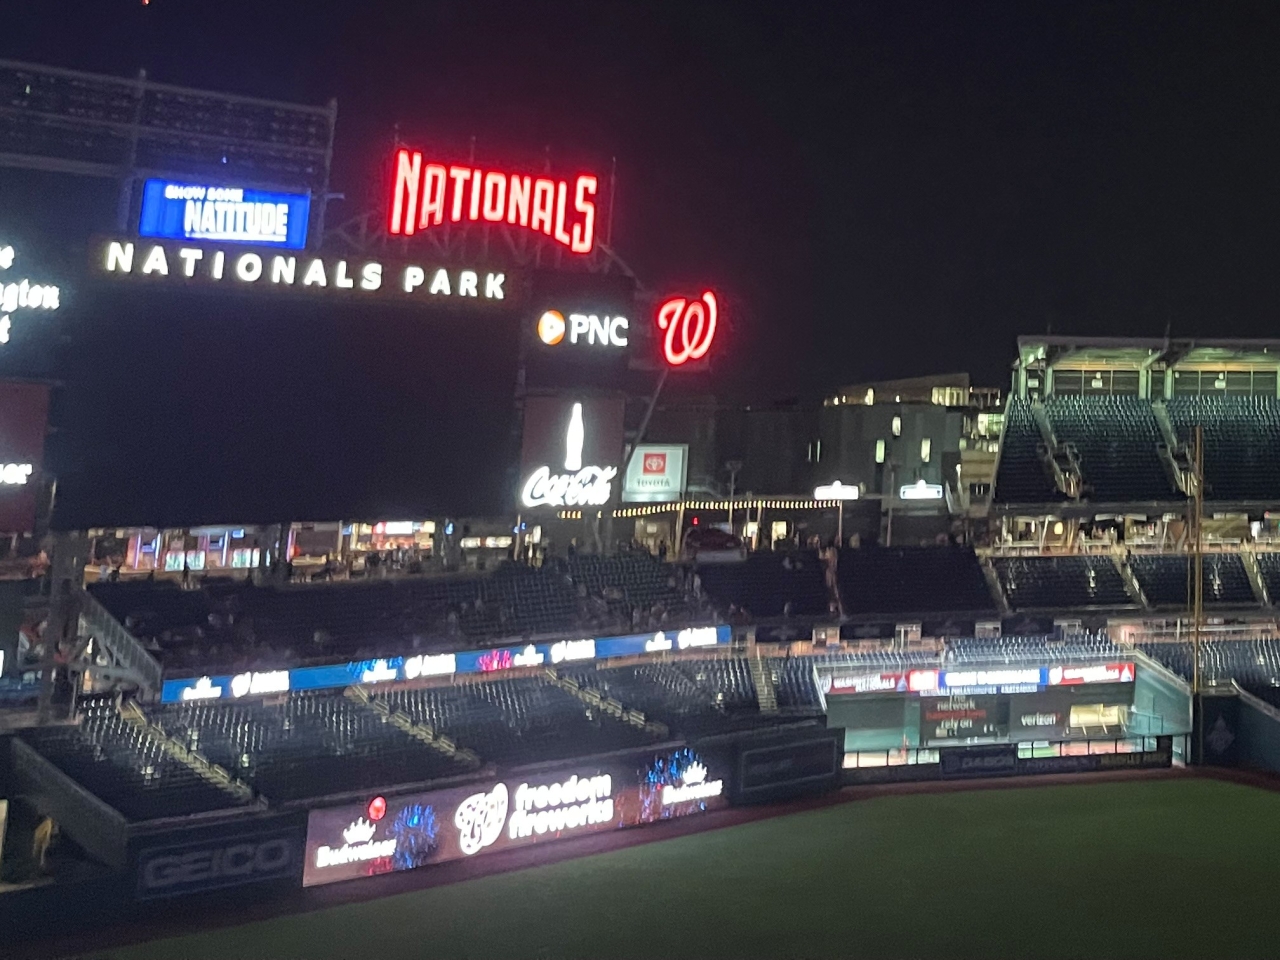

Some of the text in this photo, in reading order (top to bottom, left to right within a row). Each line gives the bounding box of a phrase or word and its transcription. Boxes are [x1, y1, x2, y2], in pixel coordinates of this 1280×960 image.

[165, 185, 243, 202] SHOW SOME
[390, 147, 597, 254] NATIONALS
[184, 200, 289, 236] NATITUDE
[106, 241, 507, 300] NATIONALS PARK
[569, 313, 629, 347] PNC
[658, 291, 718, 366] W
[522, 465, 617, 508] Coca-Cola
[636, 477, 671, 488] TOYOTA
[937, 698, 976, 711] network
[1021, 711, 1056, 726] verizon
[515, 774, 612, 812] freedom
[509, 797, 614, 839] fireworks
[148, 840, 291, 884] GEICO
